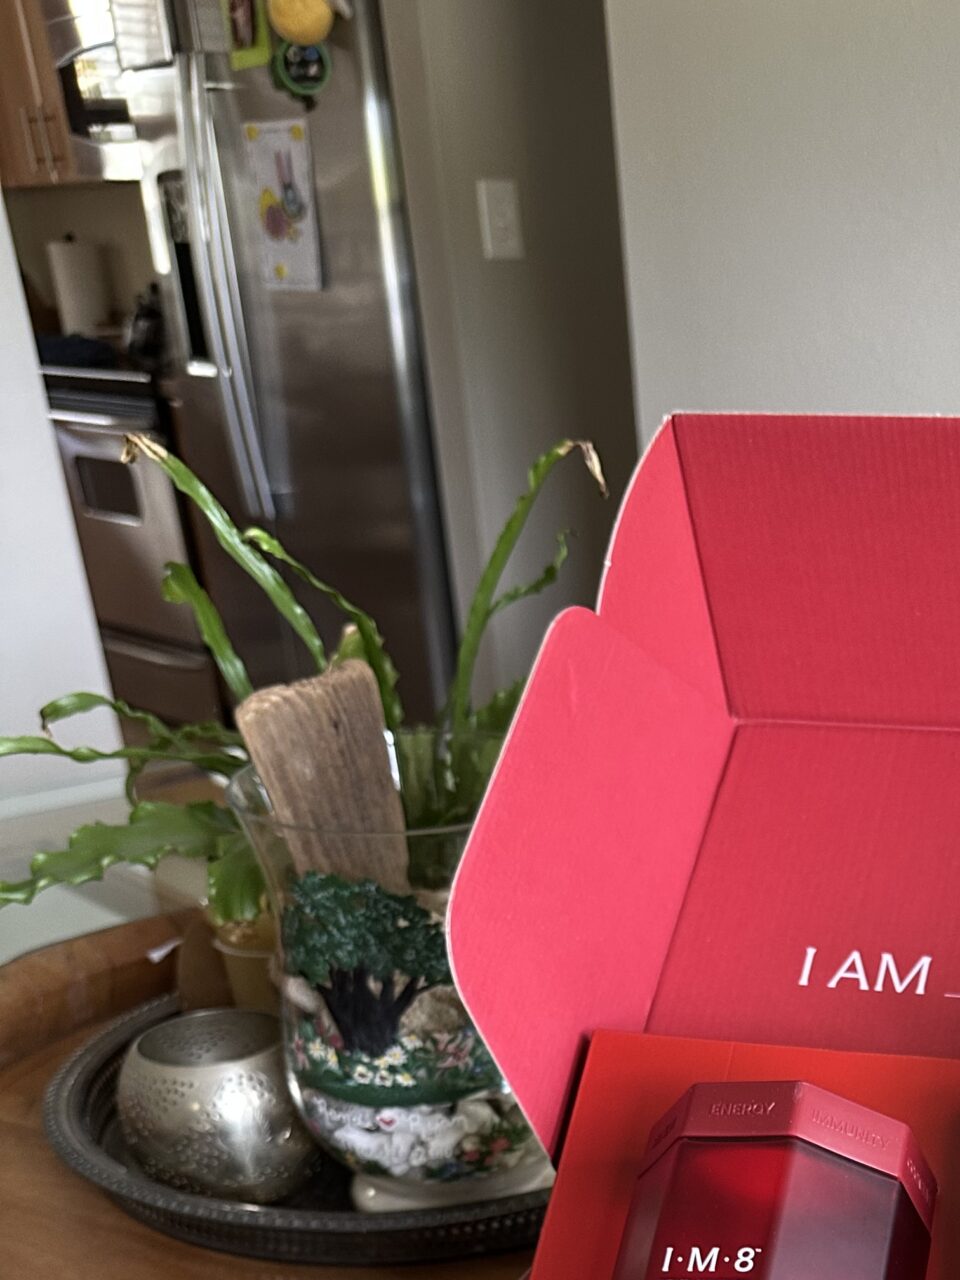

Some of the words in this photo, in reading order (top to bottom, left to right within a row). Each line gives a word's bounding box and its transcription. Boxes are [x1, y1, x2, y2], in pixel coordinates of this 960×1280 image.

[799, 947, 816, 986] I
[827, 950, 932, 995] AM
[710, 1101, 776, 1116] ENERGY
[811, 1109, 890, 1151] IMMUNITY
